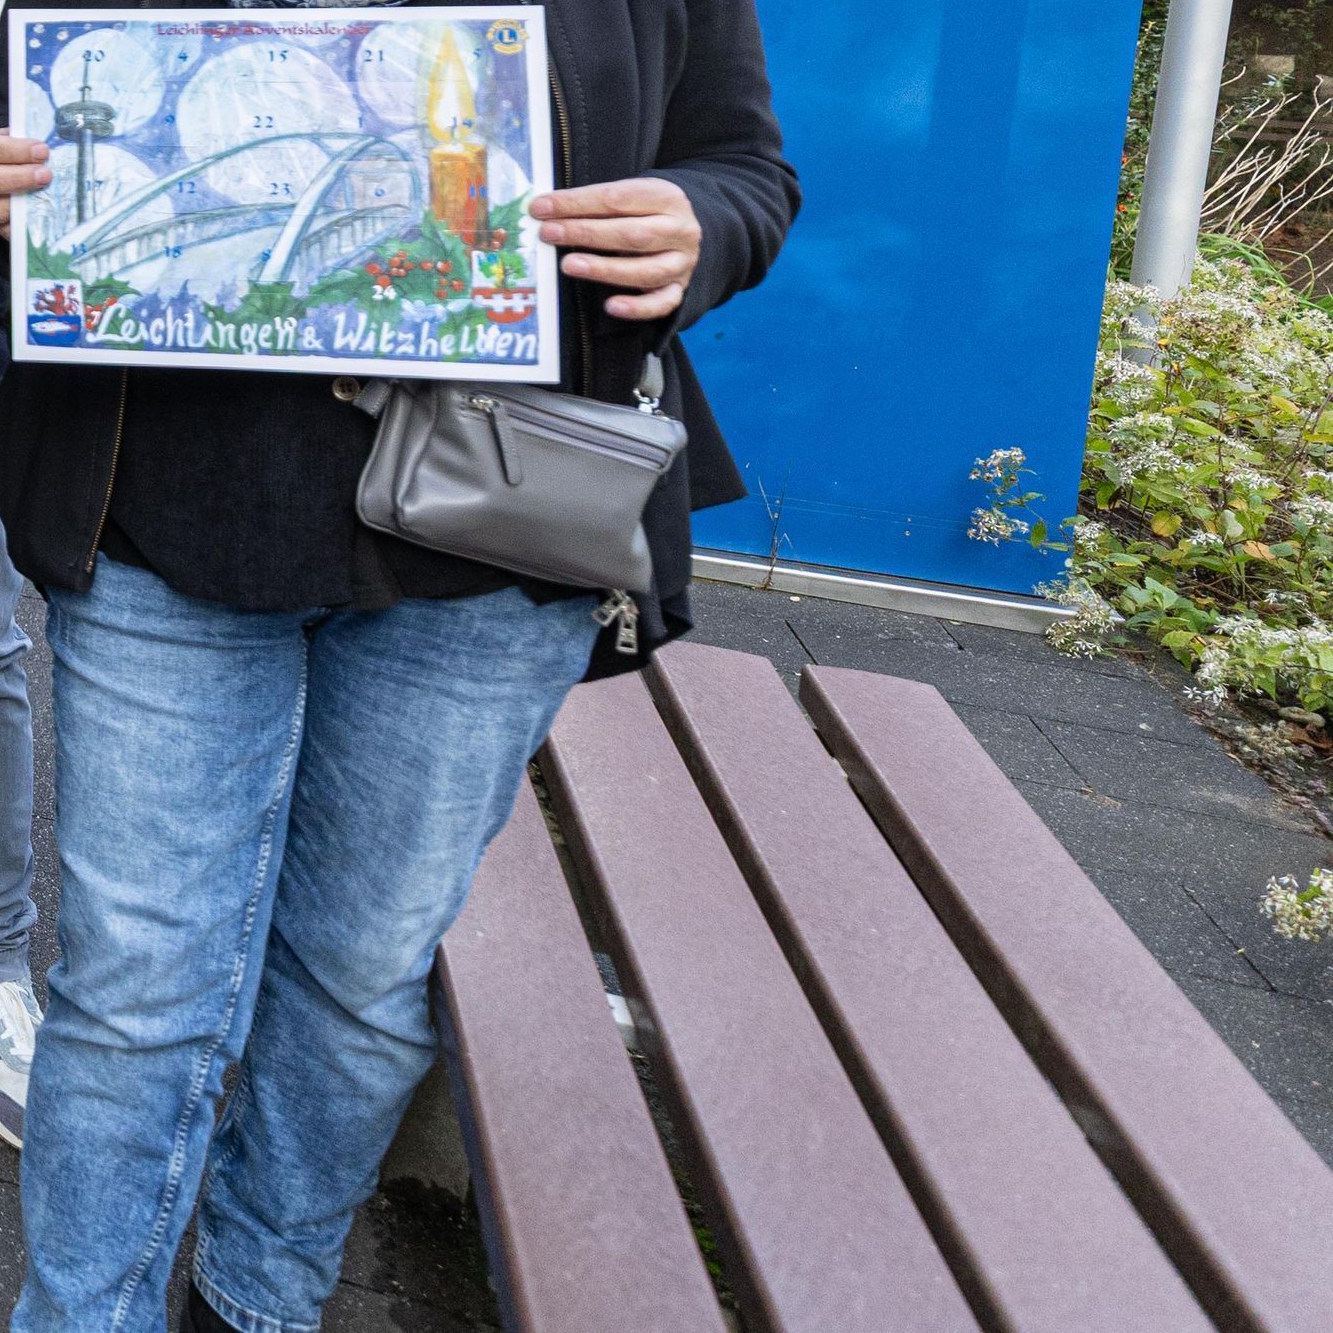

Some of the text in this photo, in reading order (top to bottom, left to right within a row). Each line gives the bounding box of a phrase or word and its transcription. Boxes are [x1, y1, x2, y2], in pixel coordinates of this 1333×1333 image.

[157, 24, 239, 37] Leichlinger
[83, 50, 105, 61] 20
[269, 50, 288, 61] 15
[364, 50, 383, 61] 21
[253, 116, 273, 128] 22
[452, 117, 473, 128] 14
[179, 182, 195, 194] 12
[270, 183, 291, 195] 23
[165, 246, 182, 258] 18
[372, 285, 396, 300] 24
[303, 326, 323, 350] &
